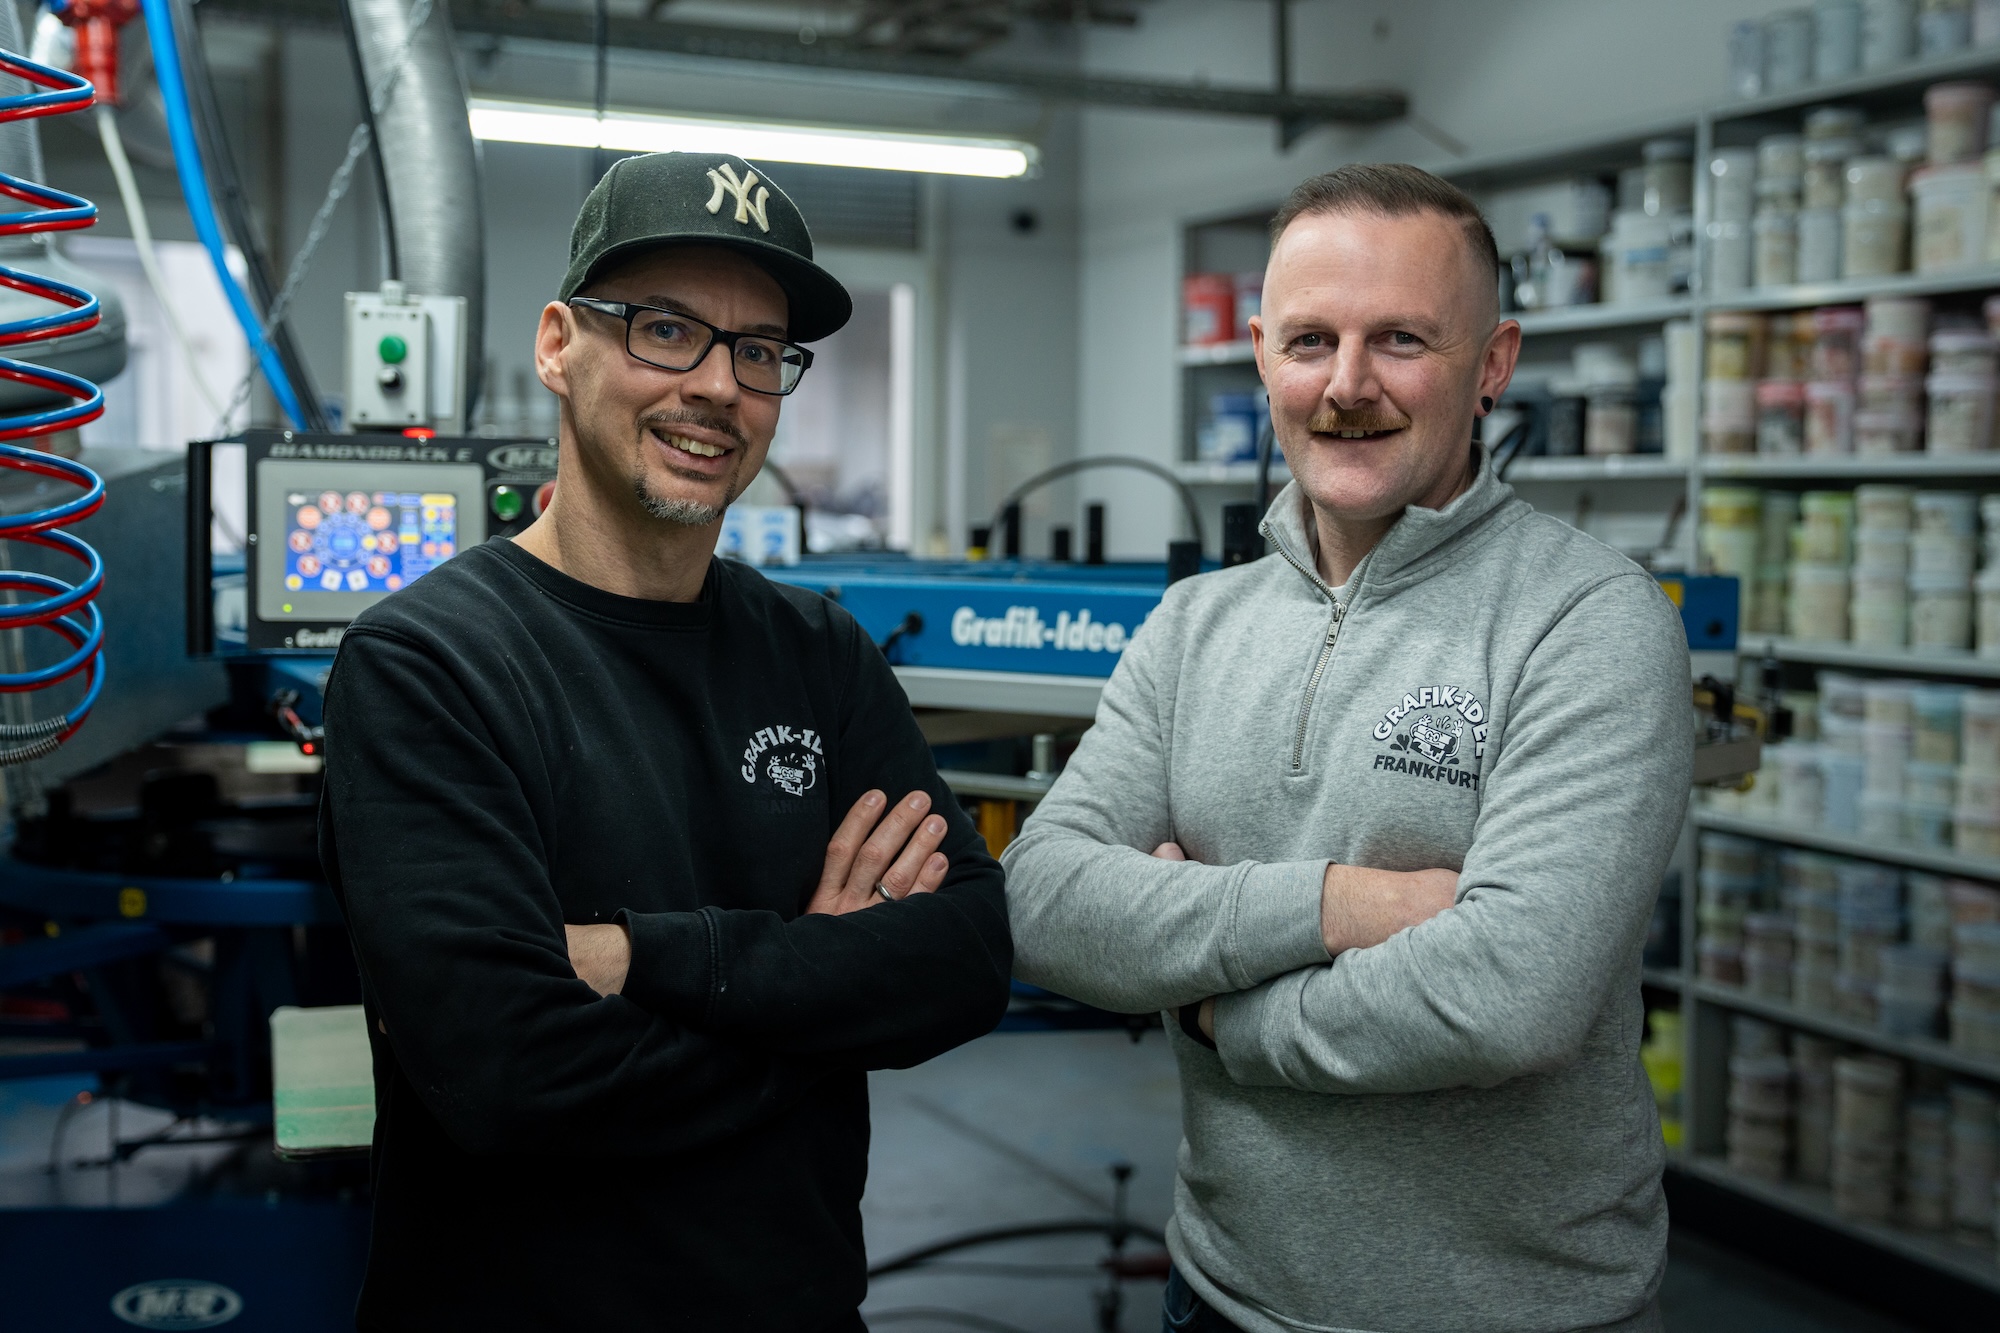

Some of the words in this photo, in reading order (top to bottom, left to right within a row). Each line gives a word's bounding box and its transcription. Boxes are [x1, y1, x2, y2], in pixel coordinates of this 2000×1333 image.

[705, 163, 770, 233] NY
[269, 442, 450, 462] DIAMONDBACK
[454, 447, 474, 463] E
[951, 605, 1153, 653] Grafik-Idee.
[1373, 755, 1480, 791] FRANKFURT
